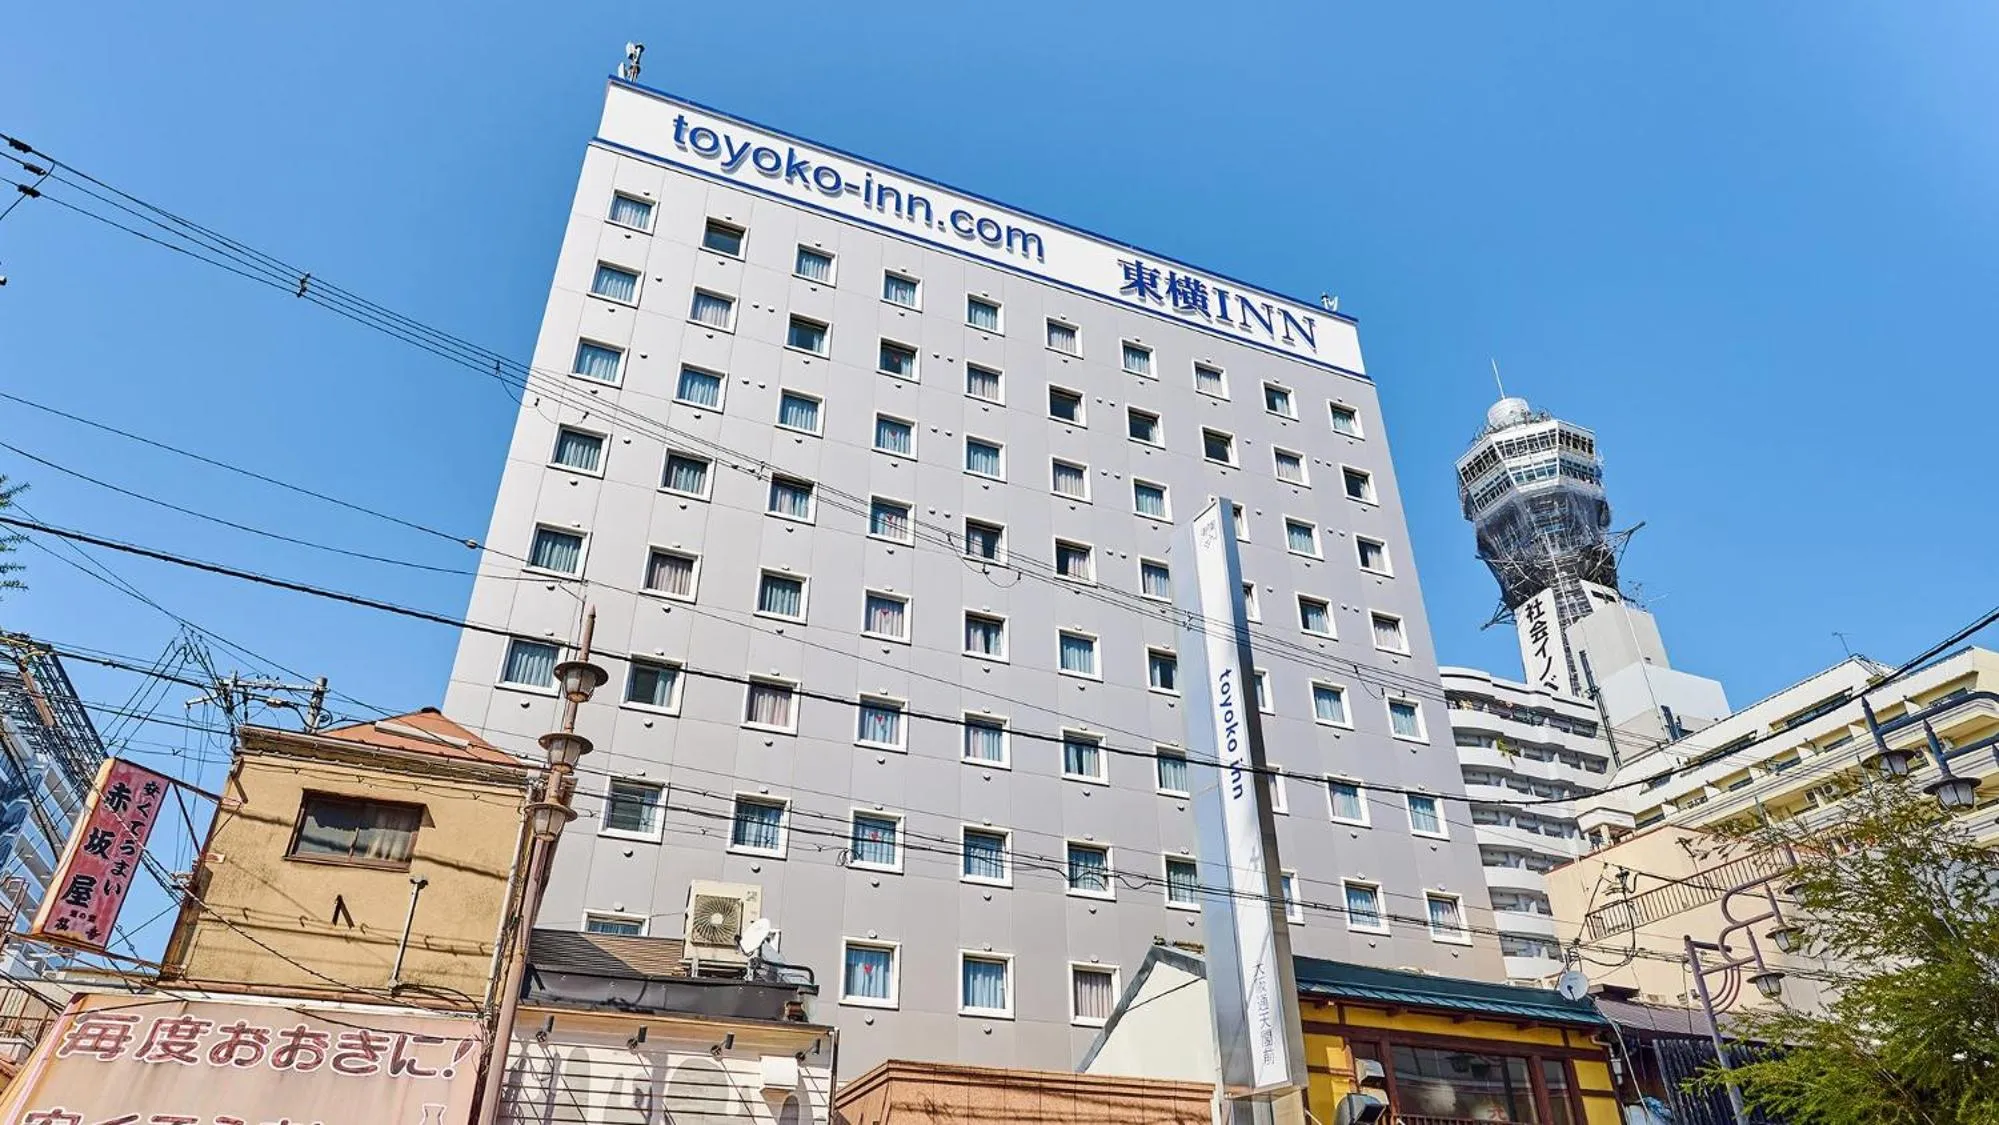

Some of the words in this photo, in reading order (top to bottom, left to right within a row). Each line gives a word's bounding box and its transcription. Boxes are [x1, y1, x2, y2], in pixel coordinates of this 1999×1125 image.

[673, 114, 1045, 263] toyoko-inn.com
[1117, 258, 1318, 352] 東横INN
[1525, 598, 1559, 692] 社会イノベ
[1219, 668, 1239, 753] toyoko
[1230, 757, 1244, 801] inn
[61, 782, 132, 908] 赤坂屋
[103, 781, 161, 896] 安くてうまい
[56, 1012, 475, 1079] 毎度おおきに!
